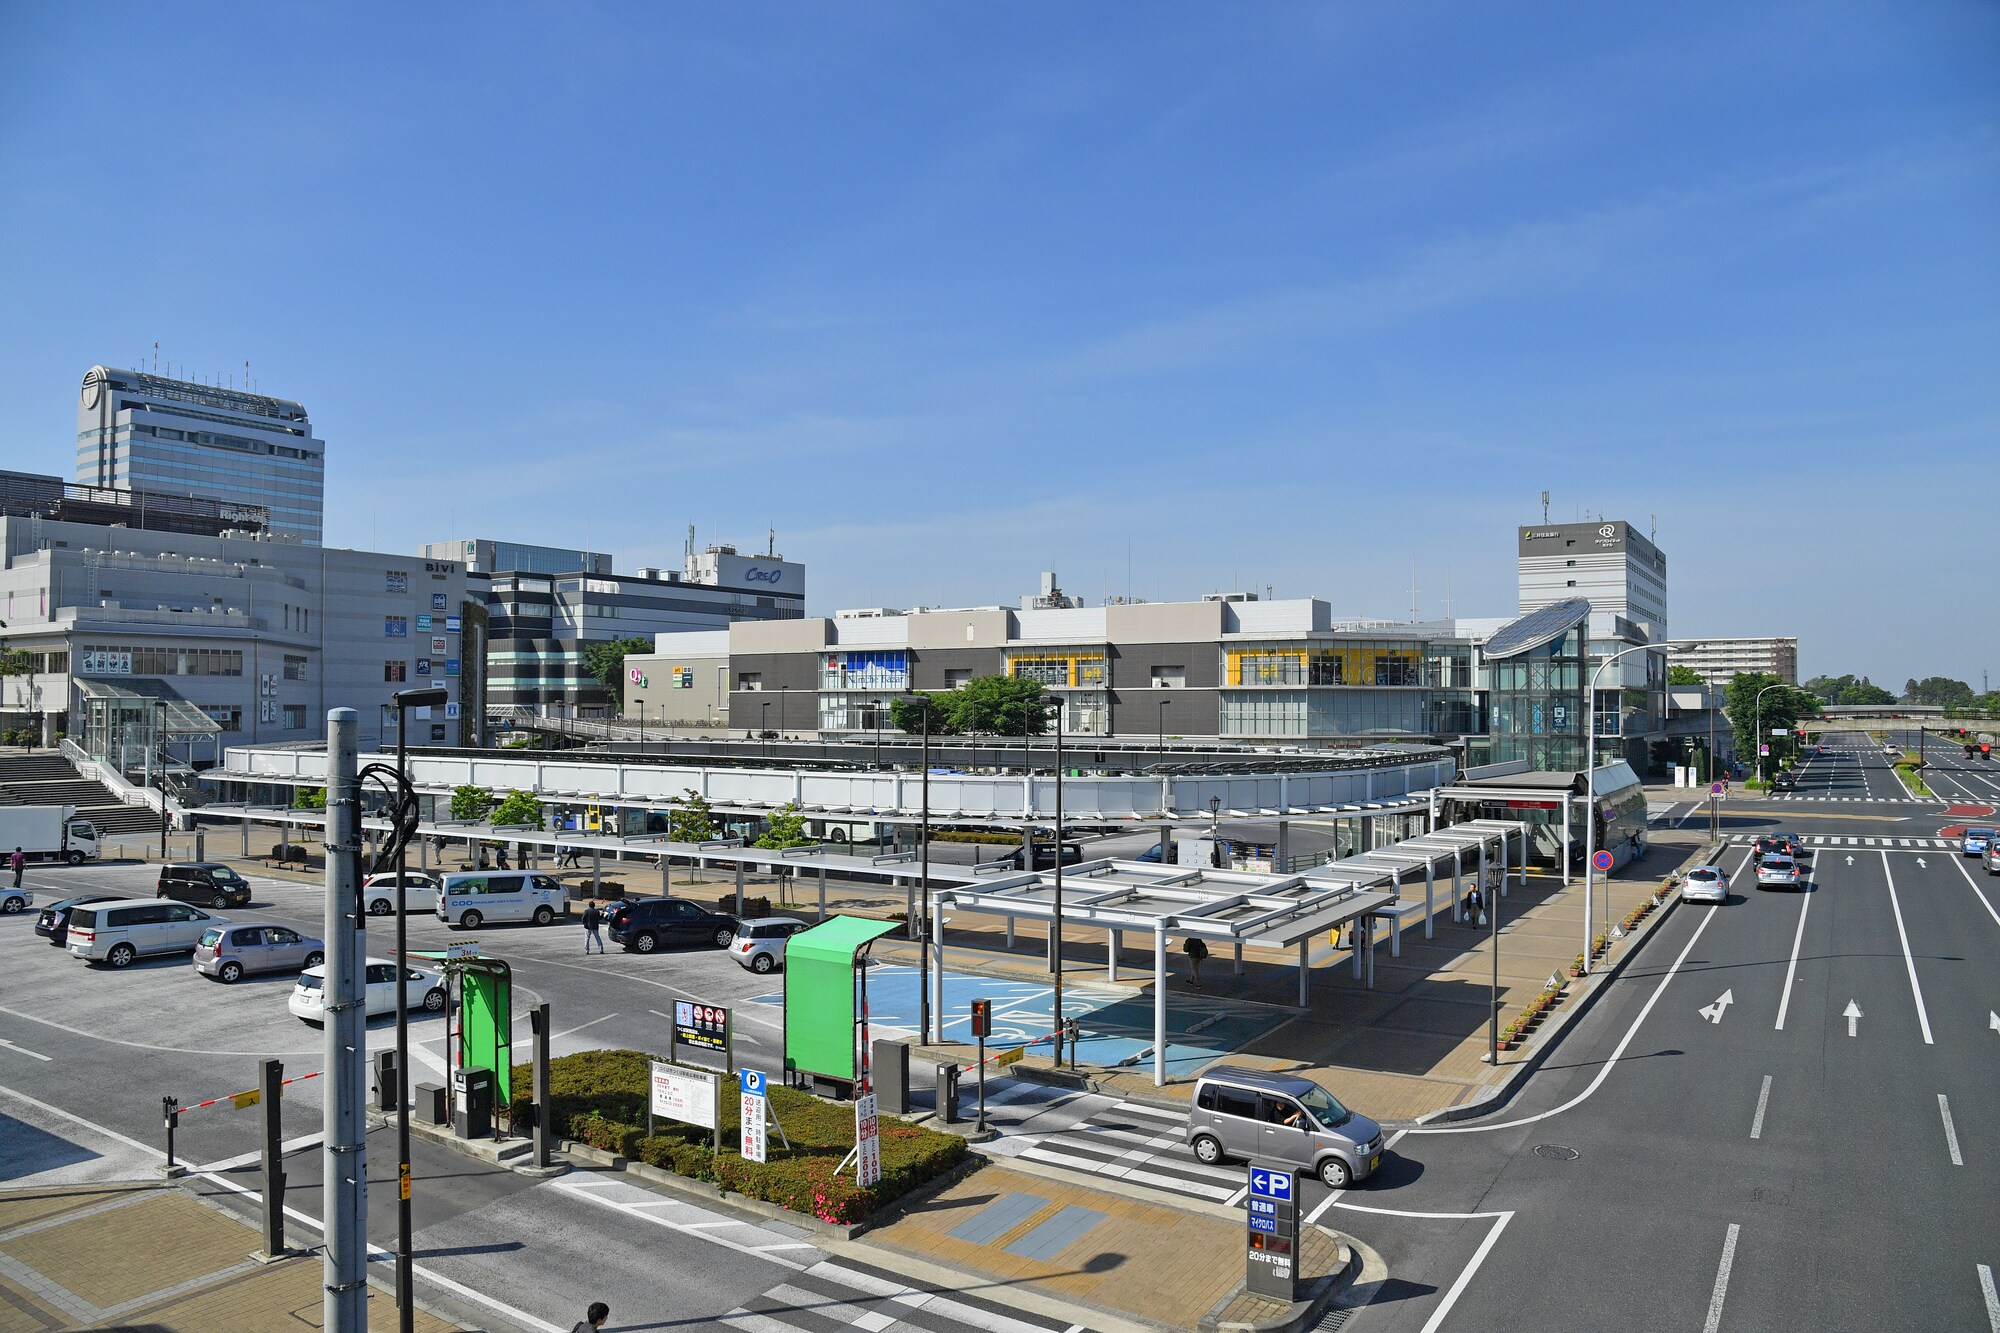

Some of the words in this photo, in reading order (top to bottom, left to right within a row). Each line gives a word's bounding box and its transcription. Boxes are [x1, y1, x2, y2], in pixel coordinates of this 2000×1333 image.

[749, 1074, 757, 1086] P
[1269, 1173, 1289, 1195] P
[1251, 1200, 1275, 1214] 普通車
[1251, 1217, 1274, 1231] マイクロバス
[1248, 1250, 1291, 1268] 20分まで無料
